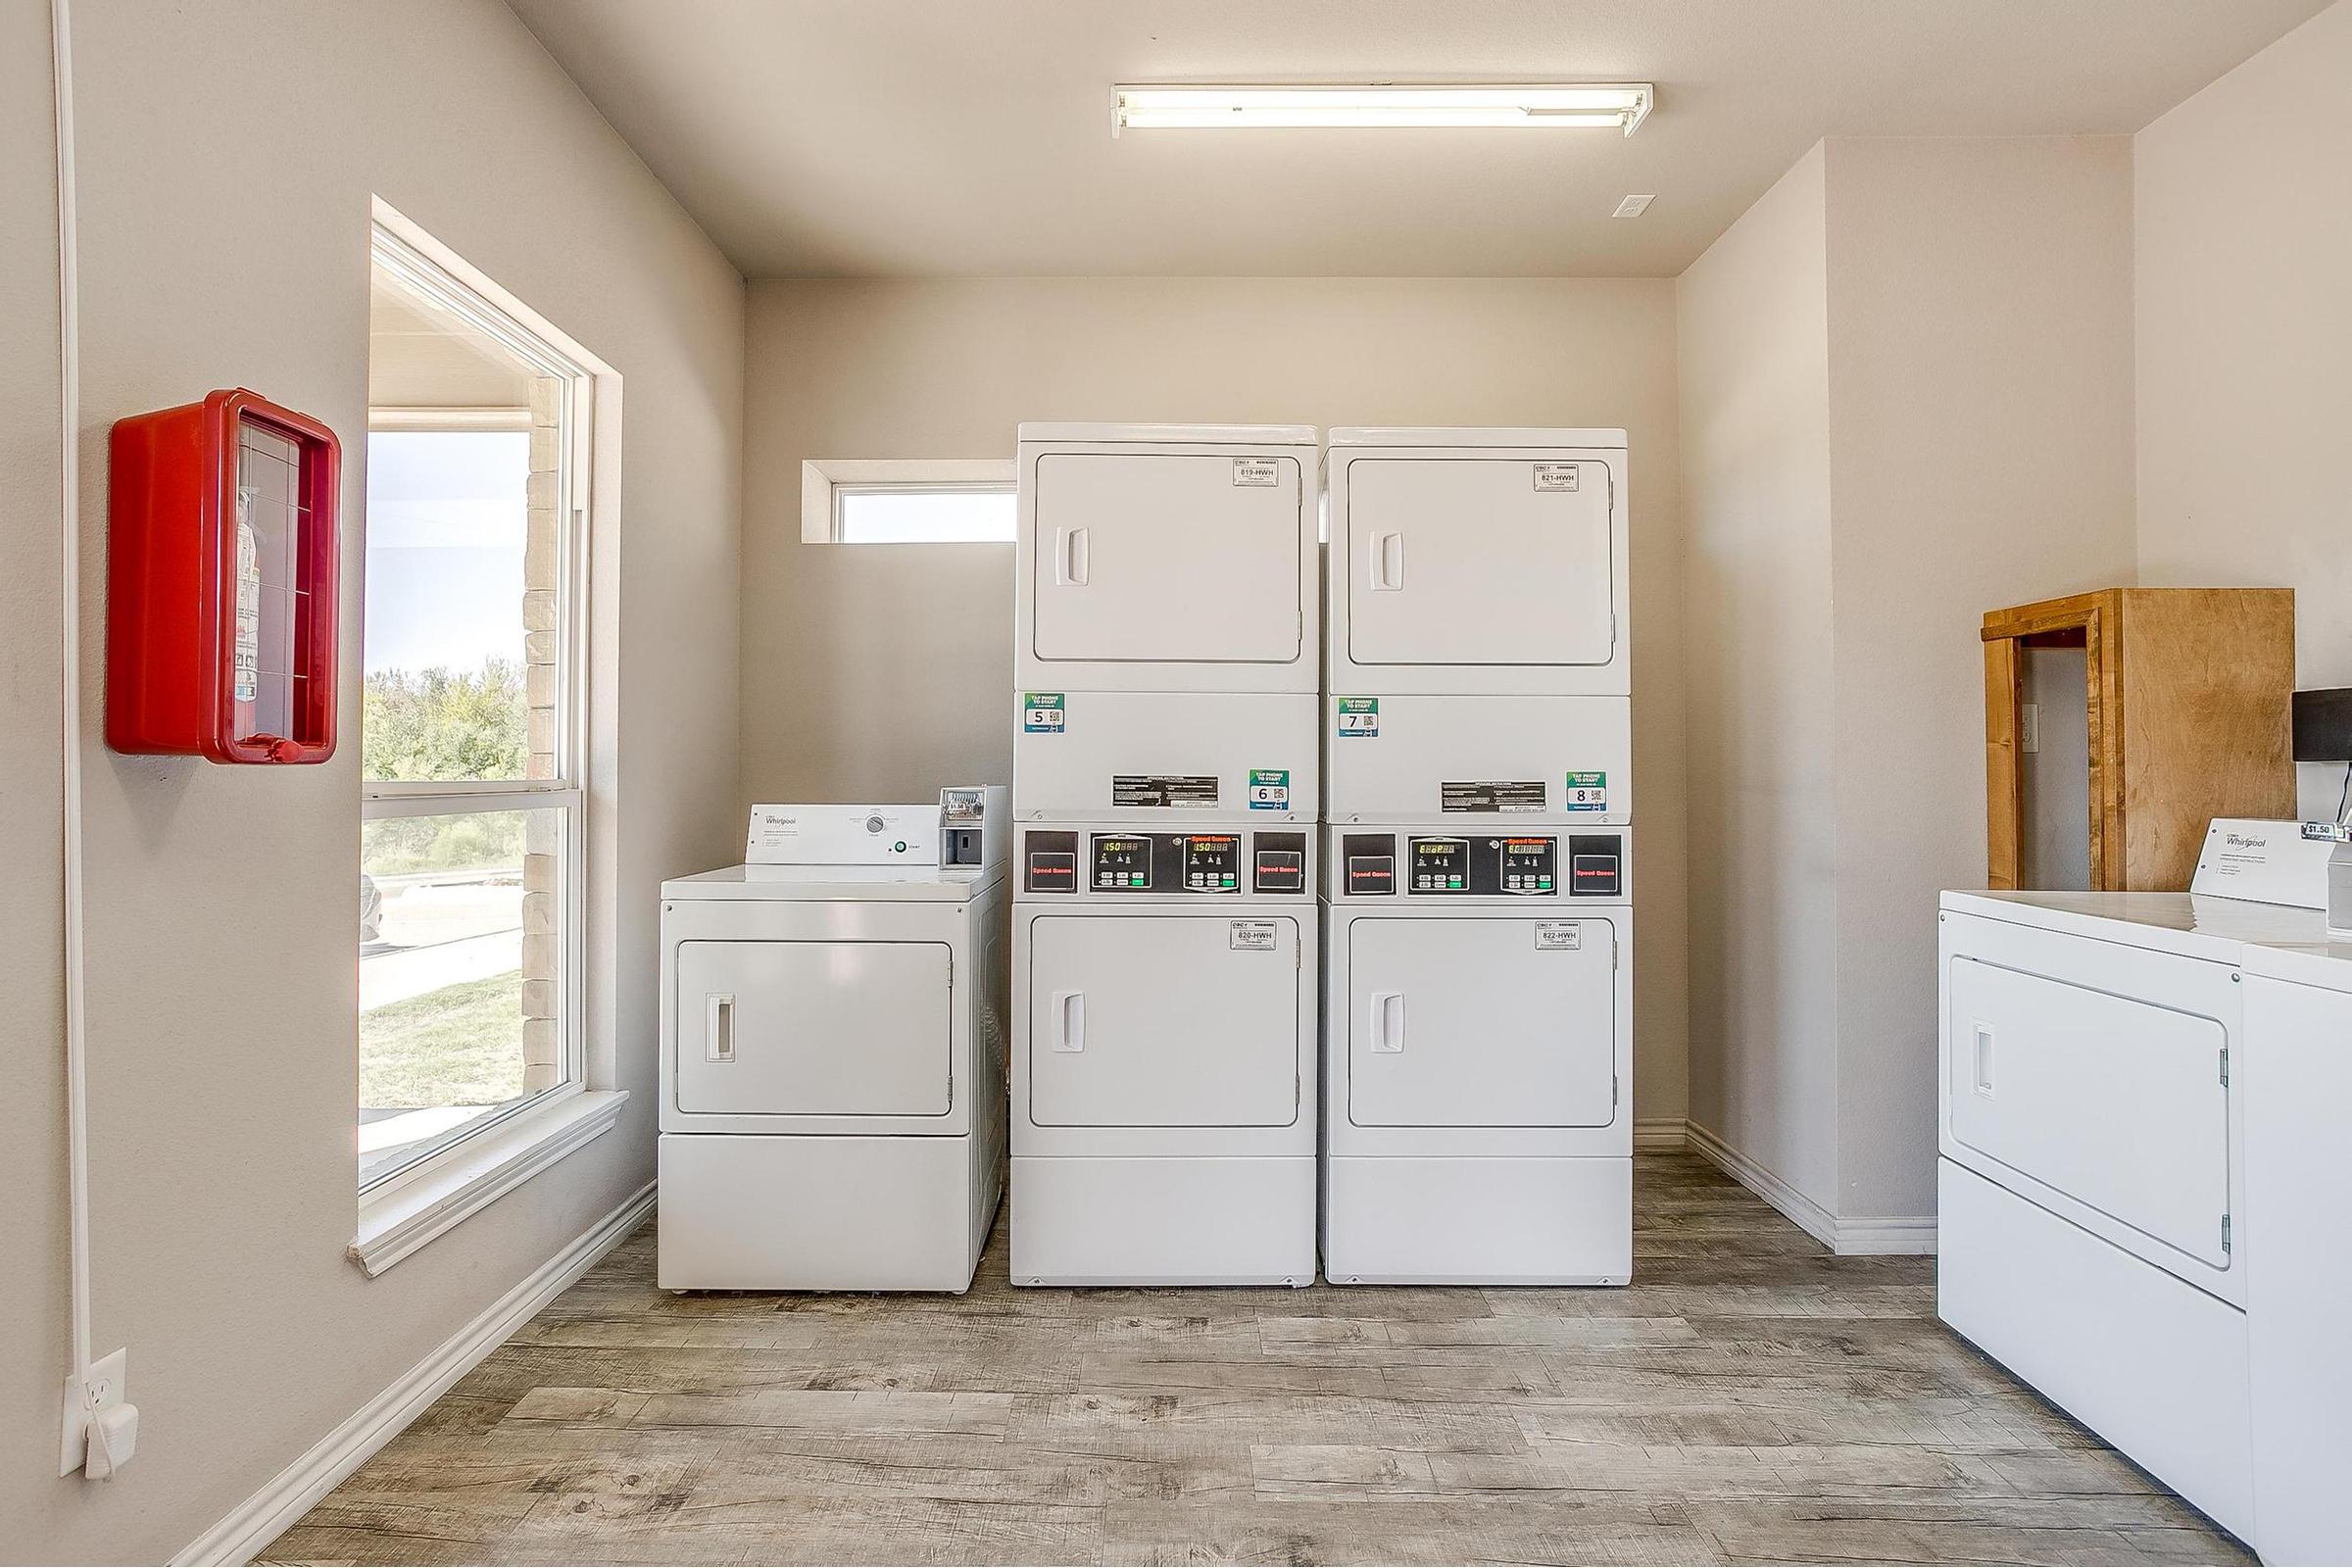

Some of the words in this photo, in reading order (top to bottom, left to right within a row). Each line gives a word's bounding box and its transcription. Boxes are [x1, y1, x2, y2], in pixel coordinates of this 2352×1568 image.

[1035, 711, 1043, 723] 5
[1349, 716, 1357, 727] 7
[1259, 789, 1267, 799] 6
[1577, 790, 1585, 801] 8
[2309, 825, 2329, 833] $1.50
[2227, 837, 2266, 848] Whirlpool
